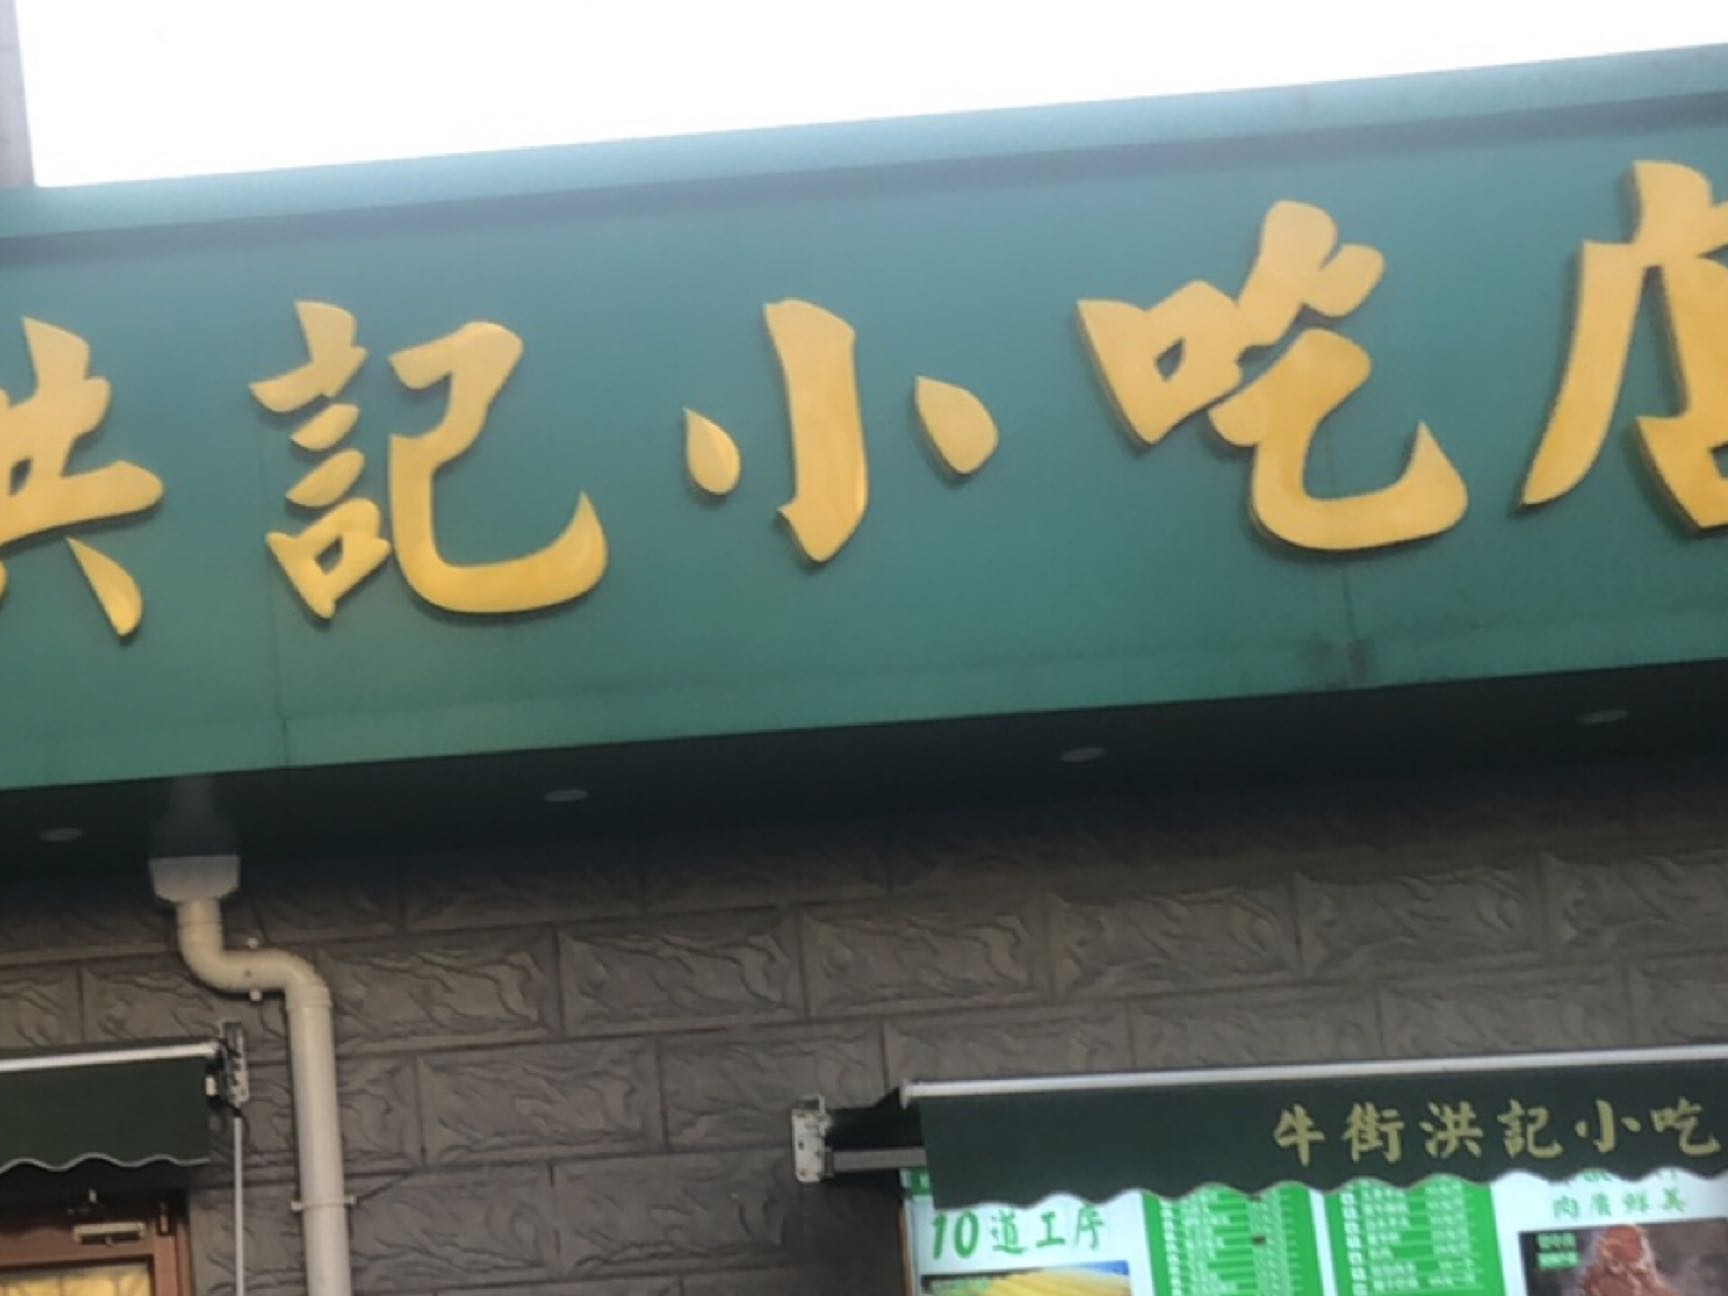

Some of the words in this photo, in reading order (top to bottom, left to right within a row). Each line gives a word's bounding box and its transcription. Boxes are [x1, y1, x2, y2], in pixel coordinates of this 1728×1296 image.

[1274, 1096, 1721, 1167] 牛街洪記小吃
[931, 1205, 1105, 1260] 10道工序
